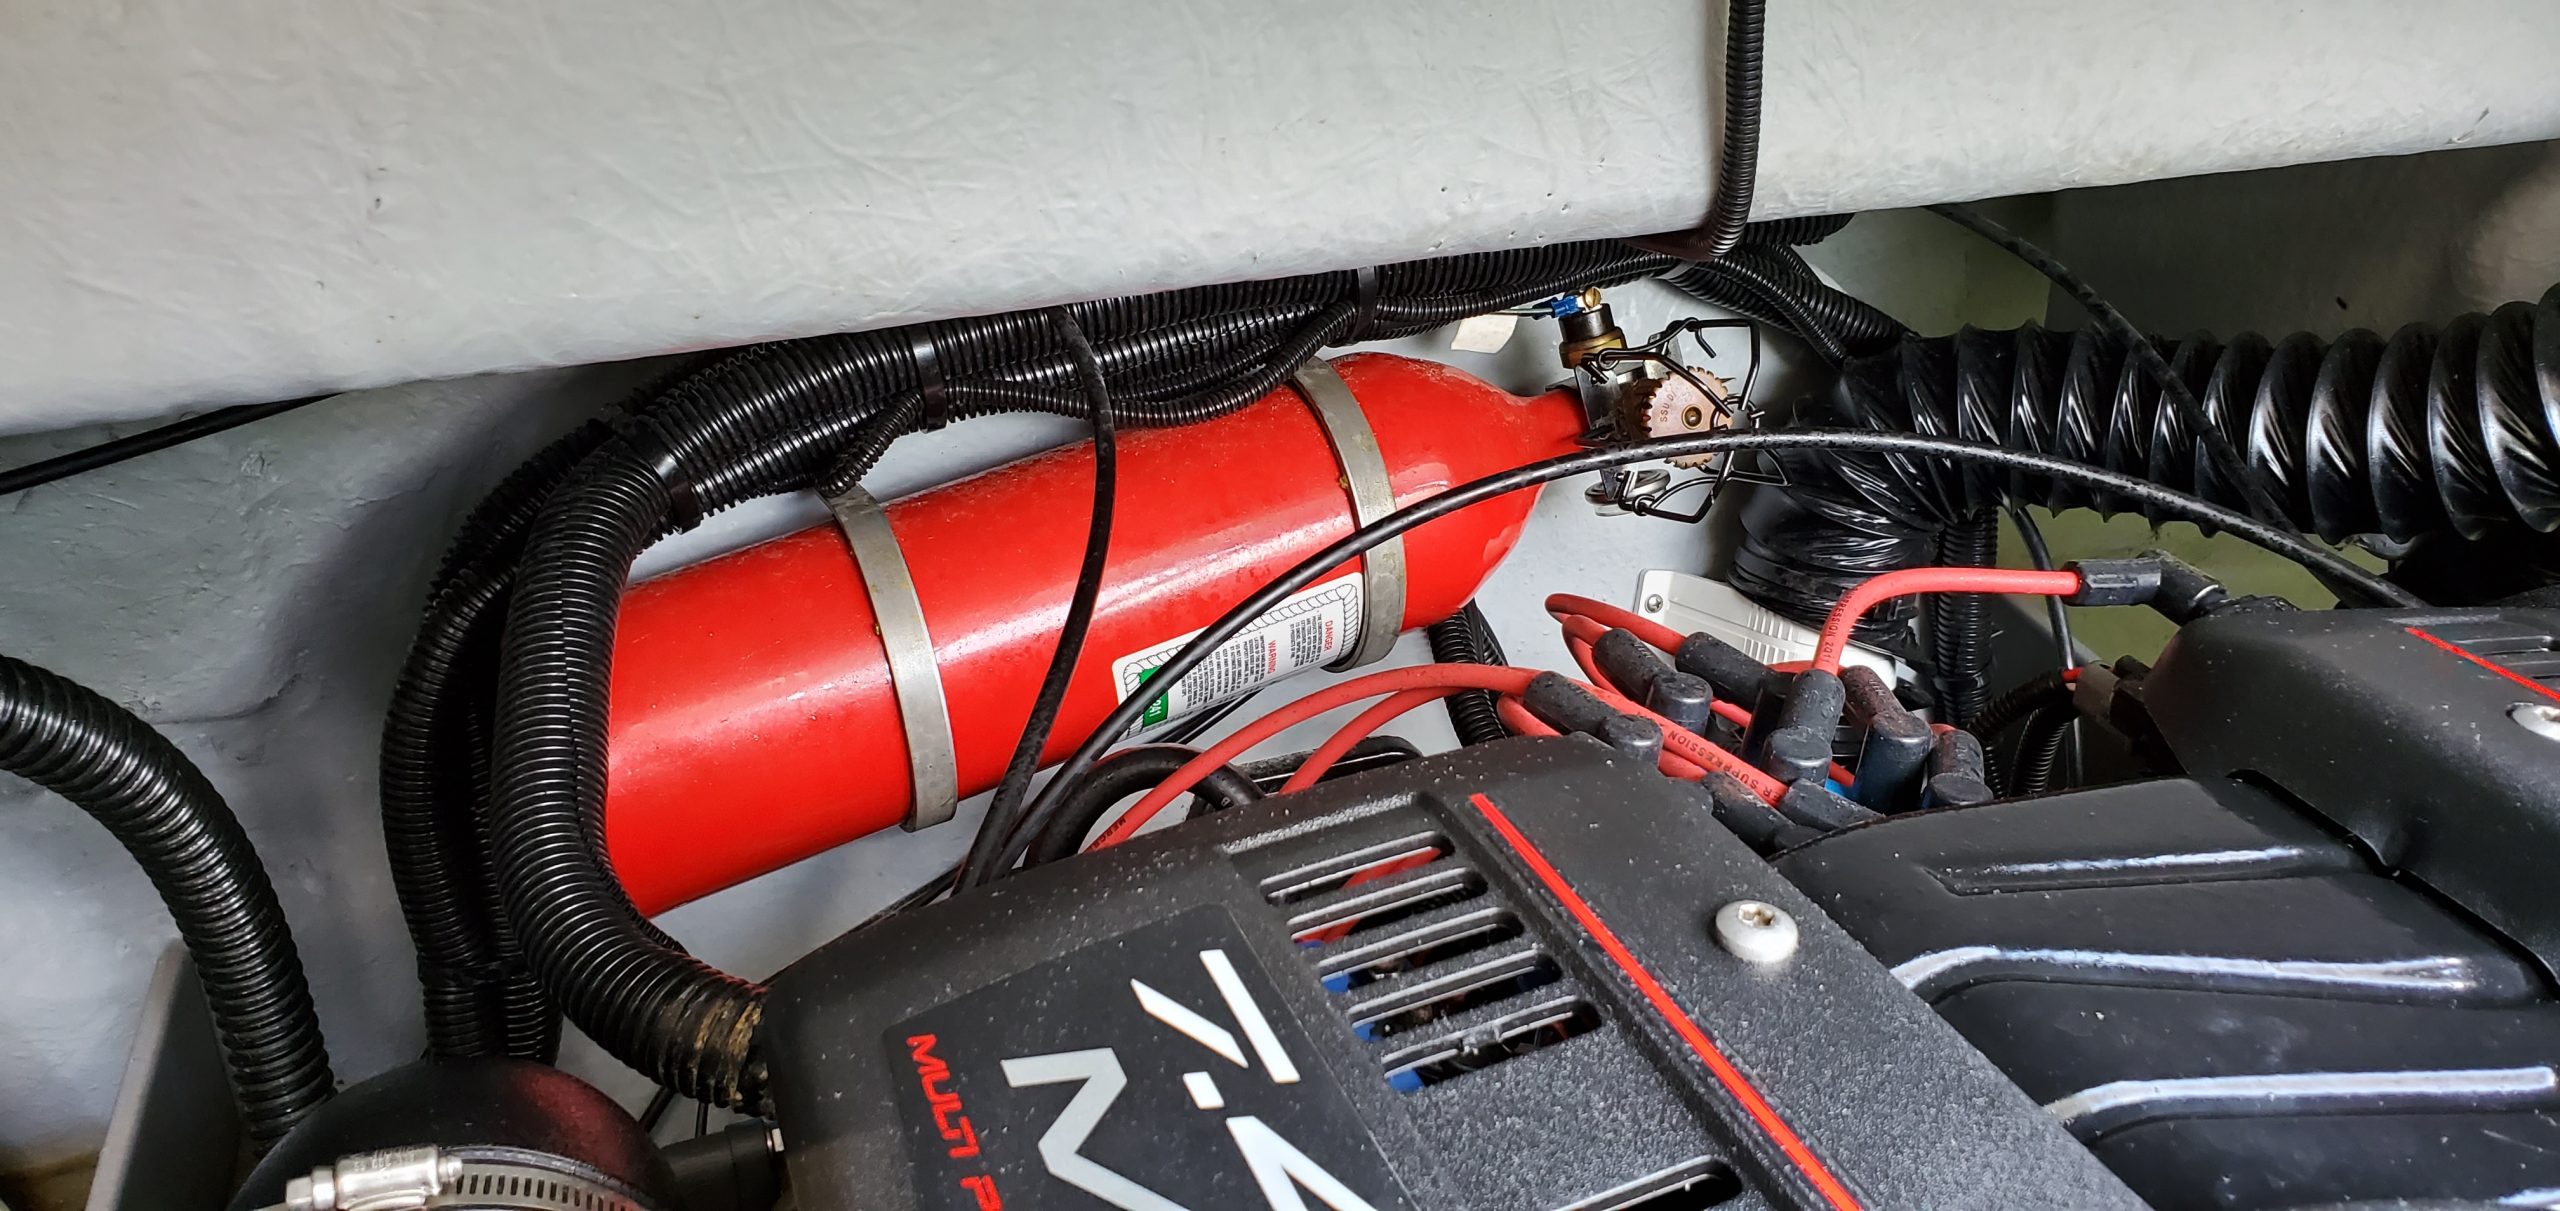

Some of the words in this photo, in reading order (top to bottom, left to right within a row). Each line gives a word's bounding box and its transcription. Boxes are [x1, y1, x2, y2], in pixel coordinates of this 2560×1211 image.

[1267, 639, 1277, 674] WARNING
[1323, 620, 1334, 652] DANGER
[1667, 729, 1760, 790] SUPPRESSION
[906, 1033, 980, 1159] MULTI
